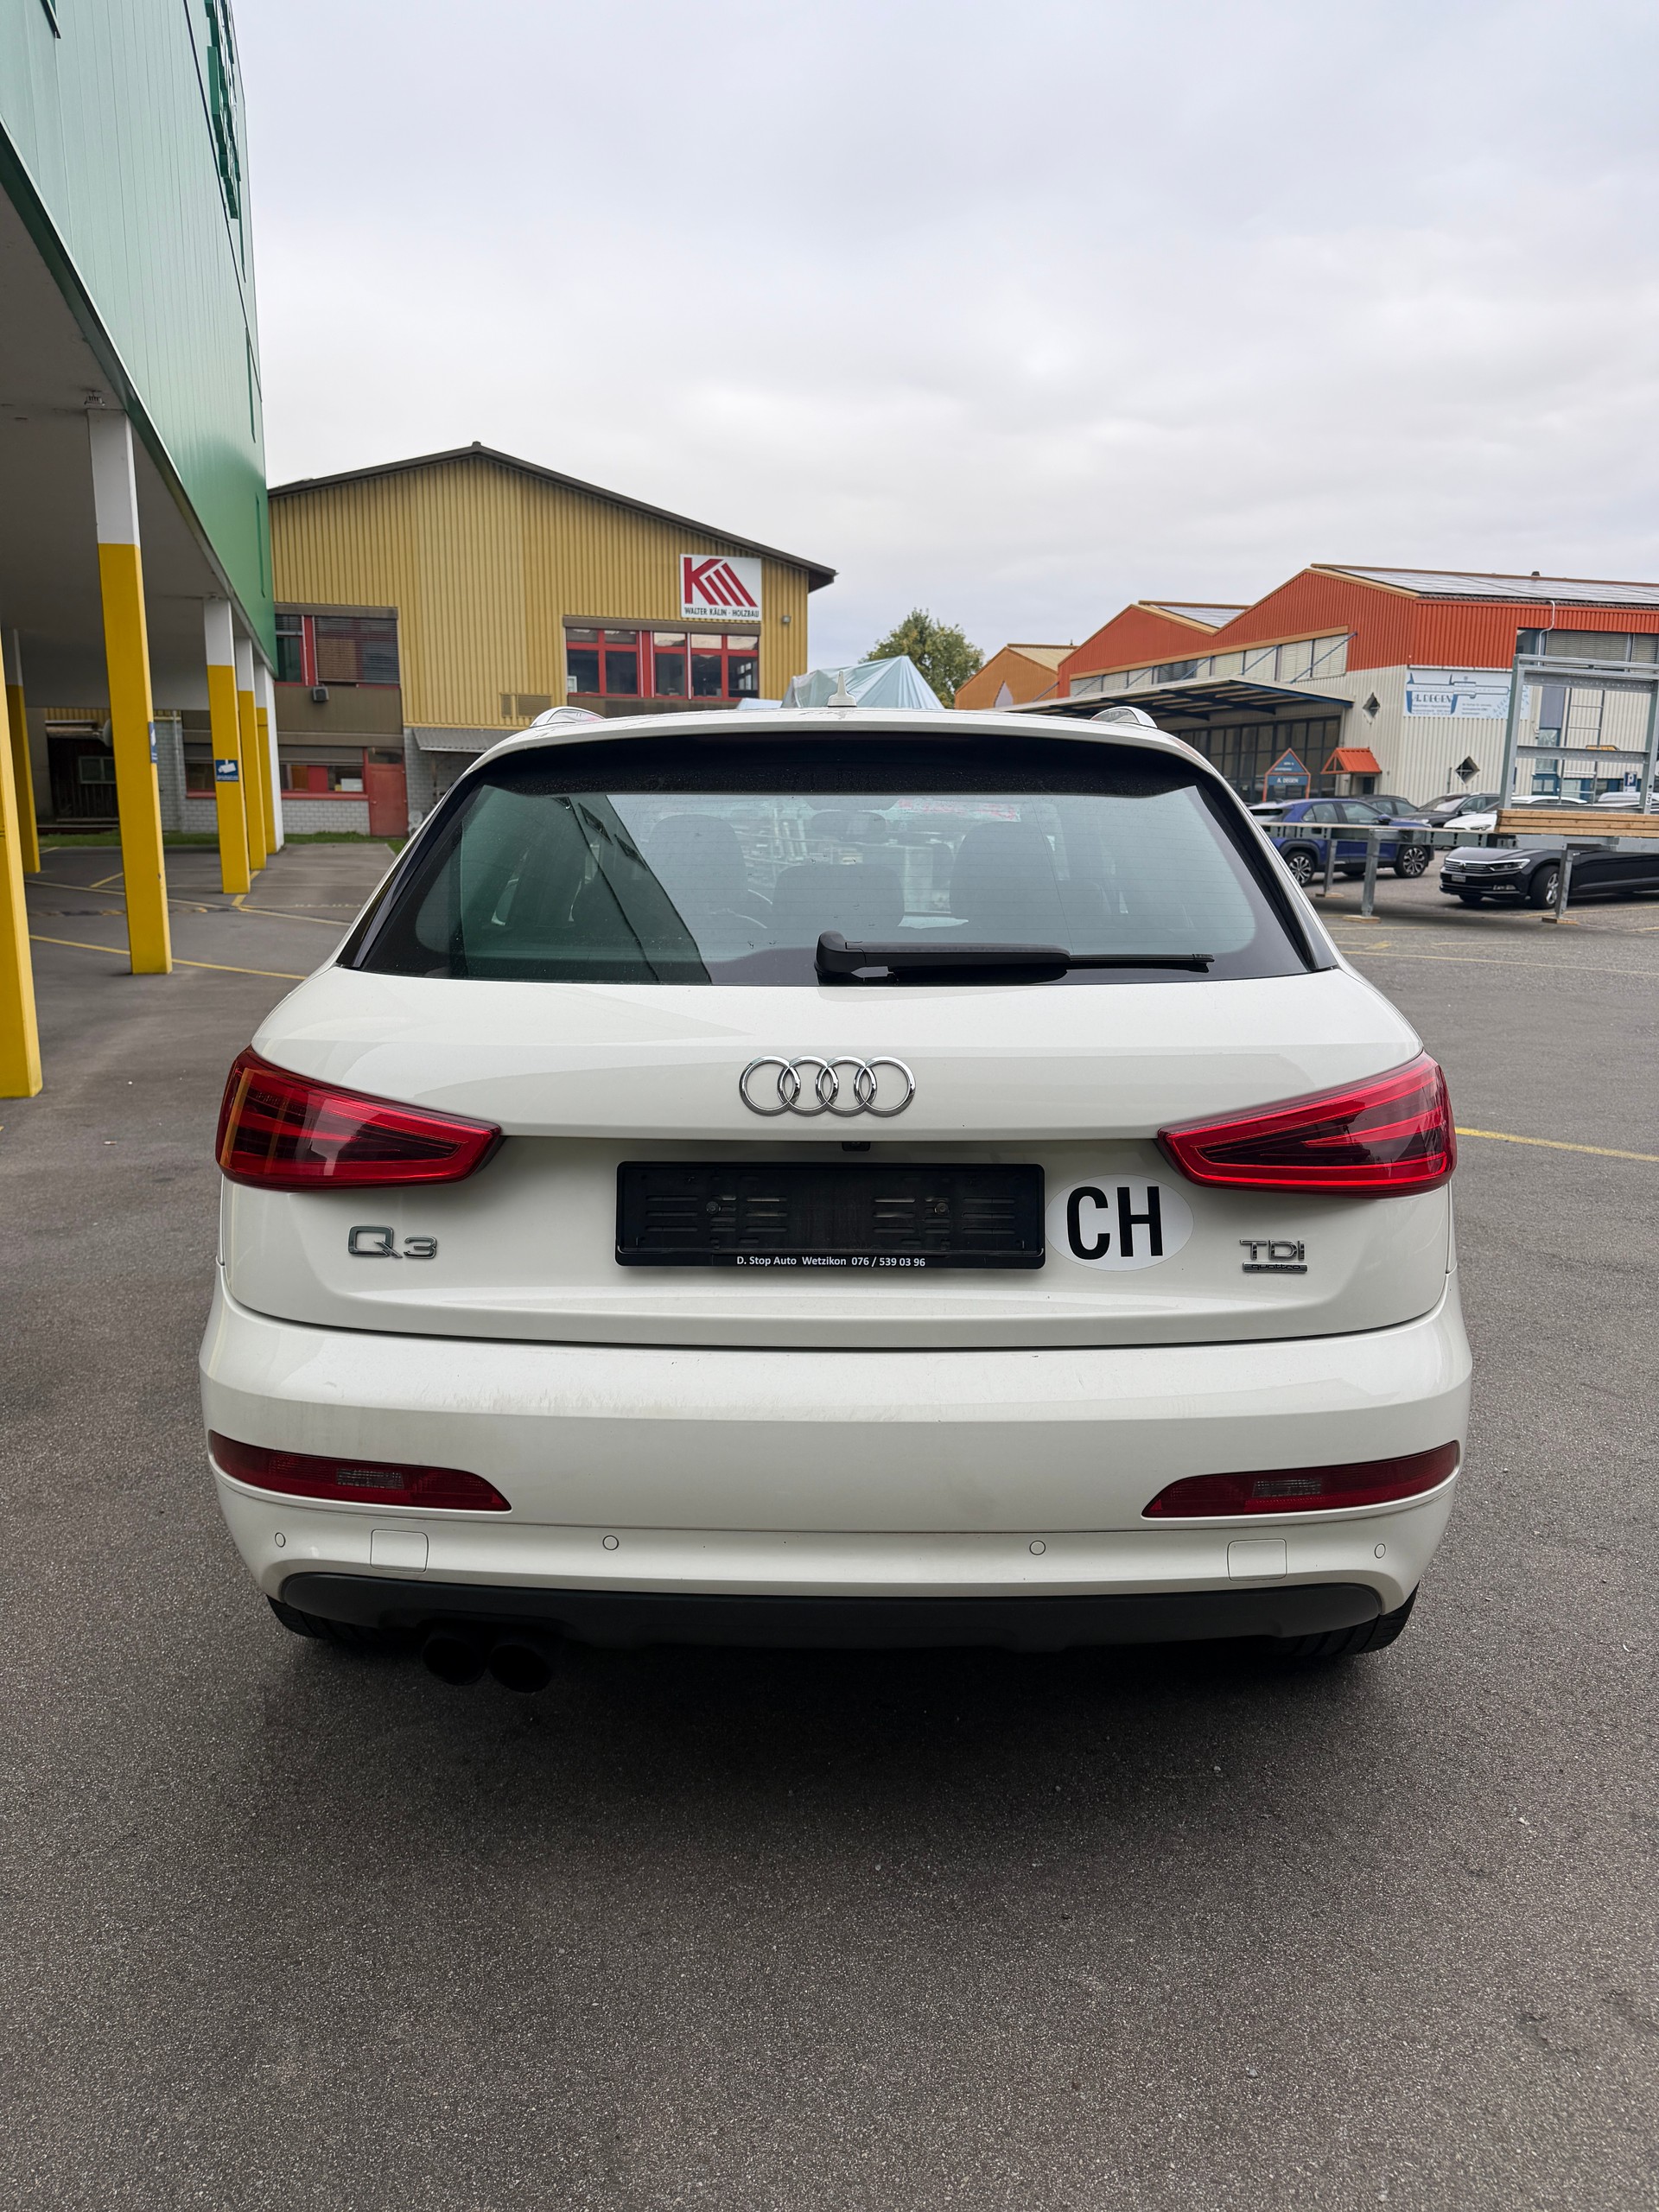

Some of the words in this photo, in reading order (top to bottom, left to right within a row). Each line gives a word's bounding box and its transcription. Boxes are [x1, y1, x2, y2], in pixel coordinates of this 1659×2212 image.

[709, 607, 728, 616] KÄLIN
[1423, 694, 1452, 703] DEGEN
[1066, 1185, 1163, 1261] CH
[347, 1224, 437, 1259] Q3
[1239, 1238, 1306, 1262] TDI
[736, 1255, 747, 1265] D.
[749, 1255, 771, 1267] Stop
[772, 1256, 797, 1265] Auto
[802, 1256, 847, 1266] Wetzikon
[851, 1256, 869, 1266] 076
[871, 1256, 877, 1268] /
[879, 1257, 897, 1267] 539
[899, 1257, 912, 1267] 03
[913, 1257, 926, 1268] 96
